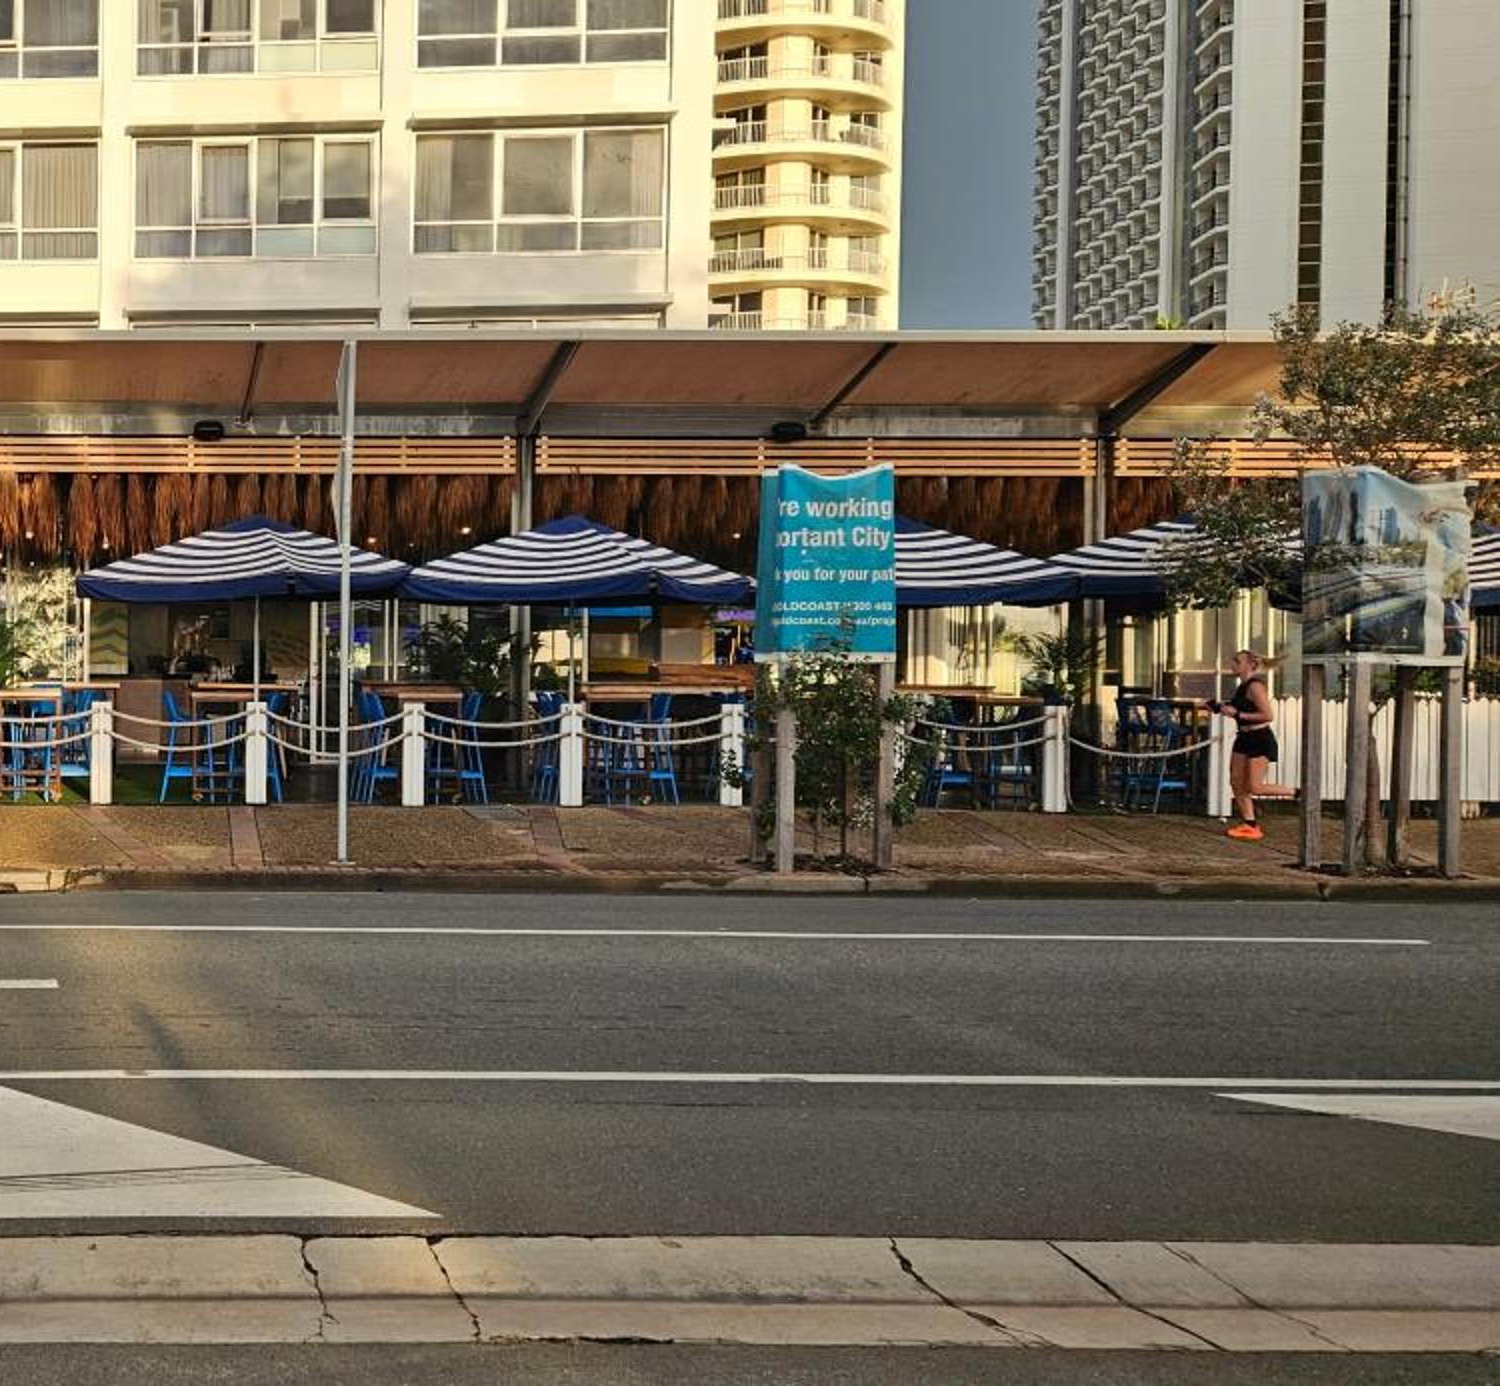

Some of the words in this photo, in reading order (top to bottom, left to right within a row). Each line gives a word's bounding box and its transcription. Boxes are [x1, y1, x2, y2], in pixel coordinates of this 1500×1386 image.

[805, 497, 893, 520] working
[852, 526, 890, 551] City
[784, 569, 809, 583] you
[814, 568, 835, 581] for
[839, 569, 869, 583] your
